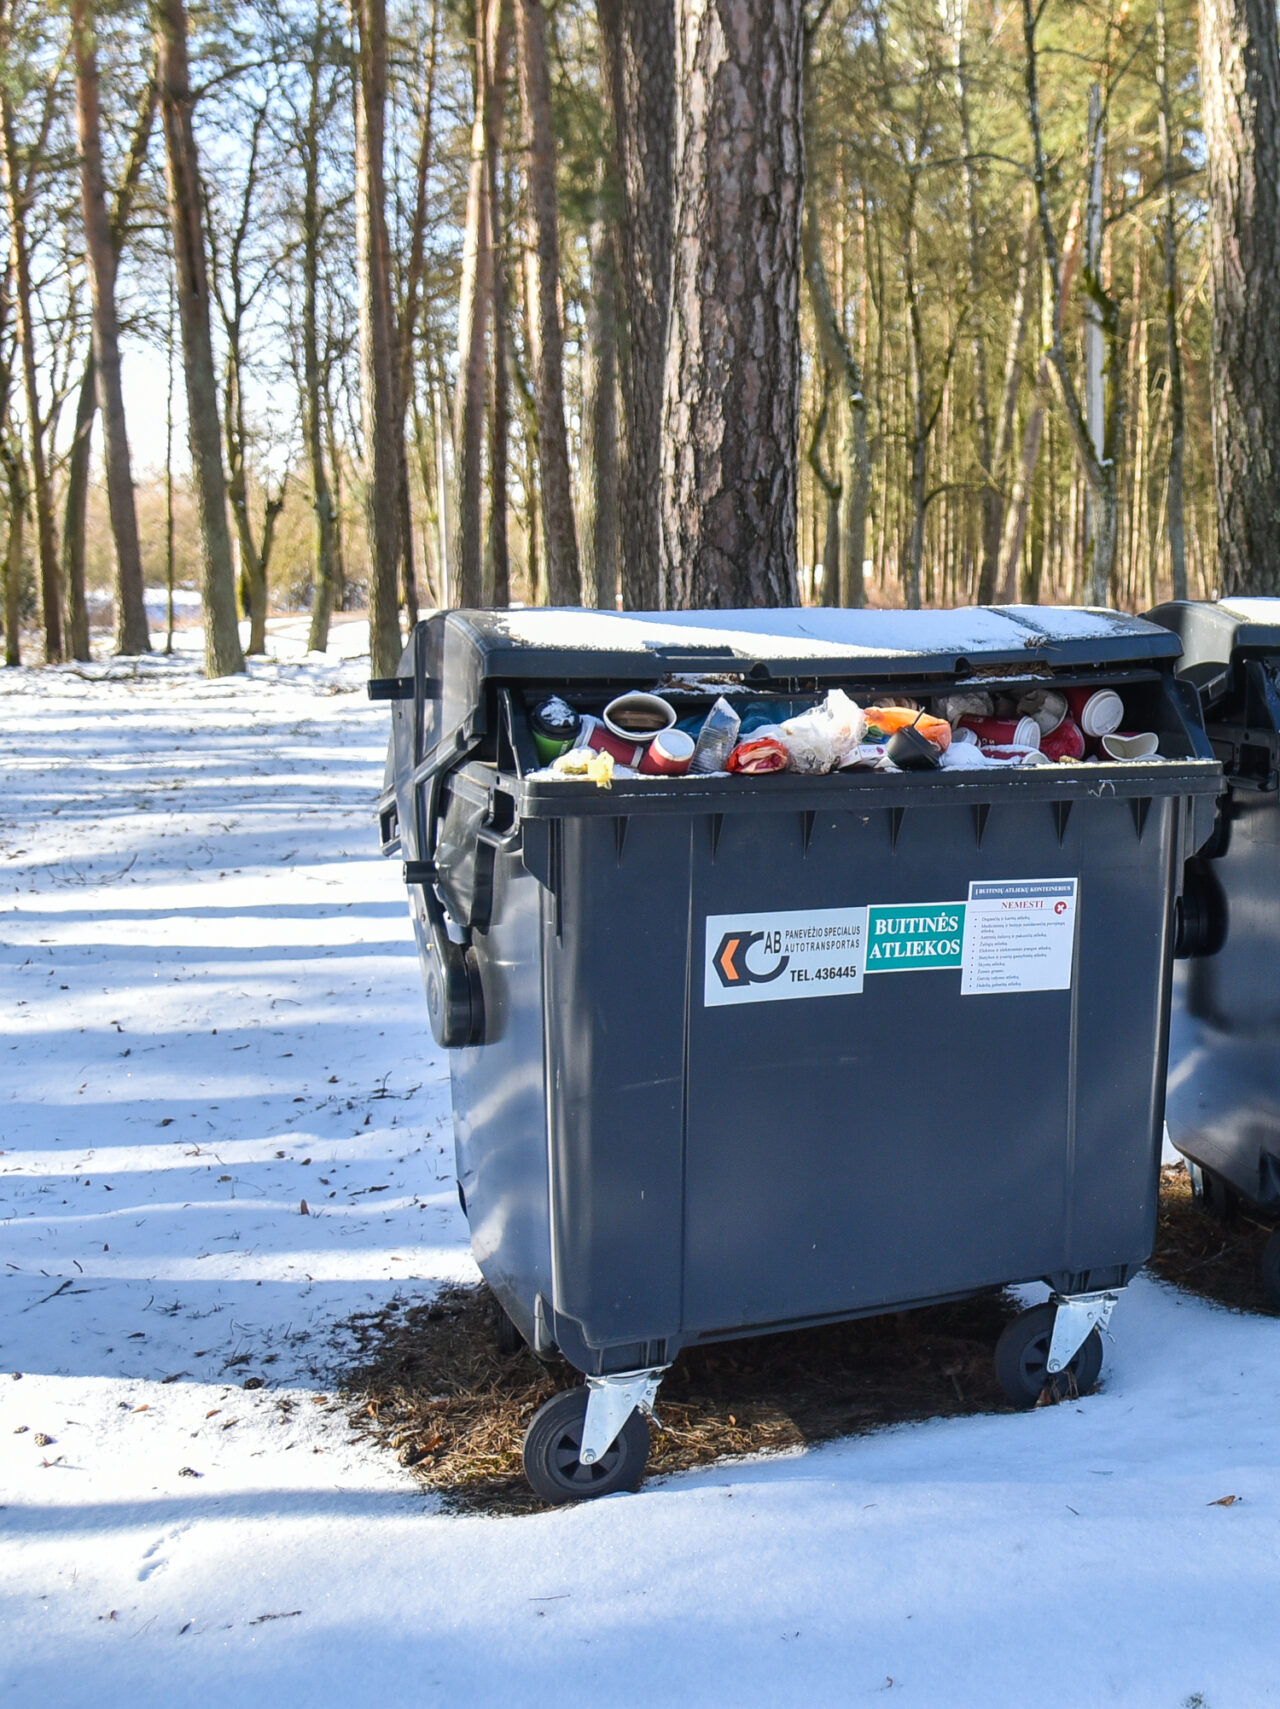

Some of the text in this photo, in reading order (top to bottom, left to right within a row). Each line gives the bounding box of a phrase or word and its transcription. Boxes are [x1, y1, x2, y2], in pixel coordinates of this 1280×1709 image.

[785, 925, 861, 940] PANEVĖŽIO SPECIALUS
[874, 911, 959, 935] BUITINĖS
[763, 930, 782, 955] AB
[784, 938, 860, 953] AUTOTRANSPORTAS
[869, 939, 960, 959] ATLIEKOS
[790, 965, 857, 983] TEL.436445
